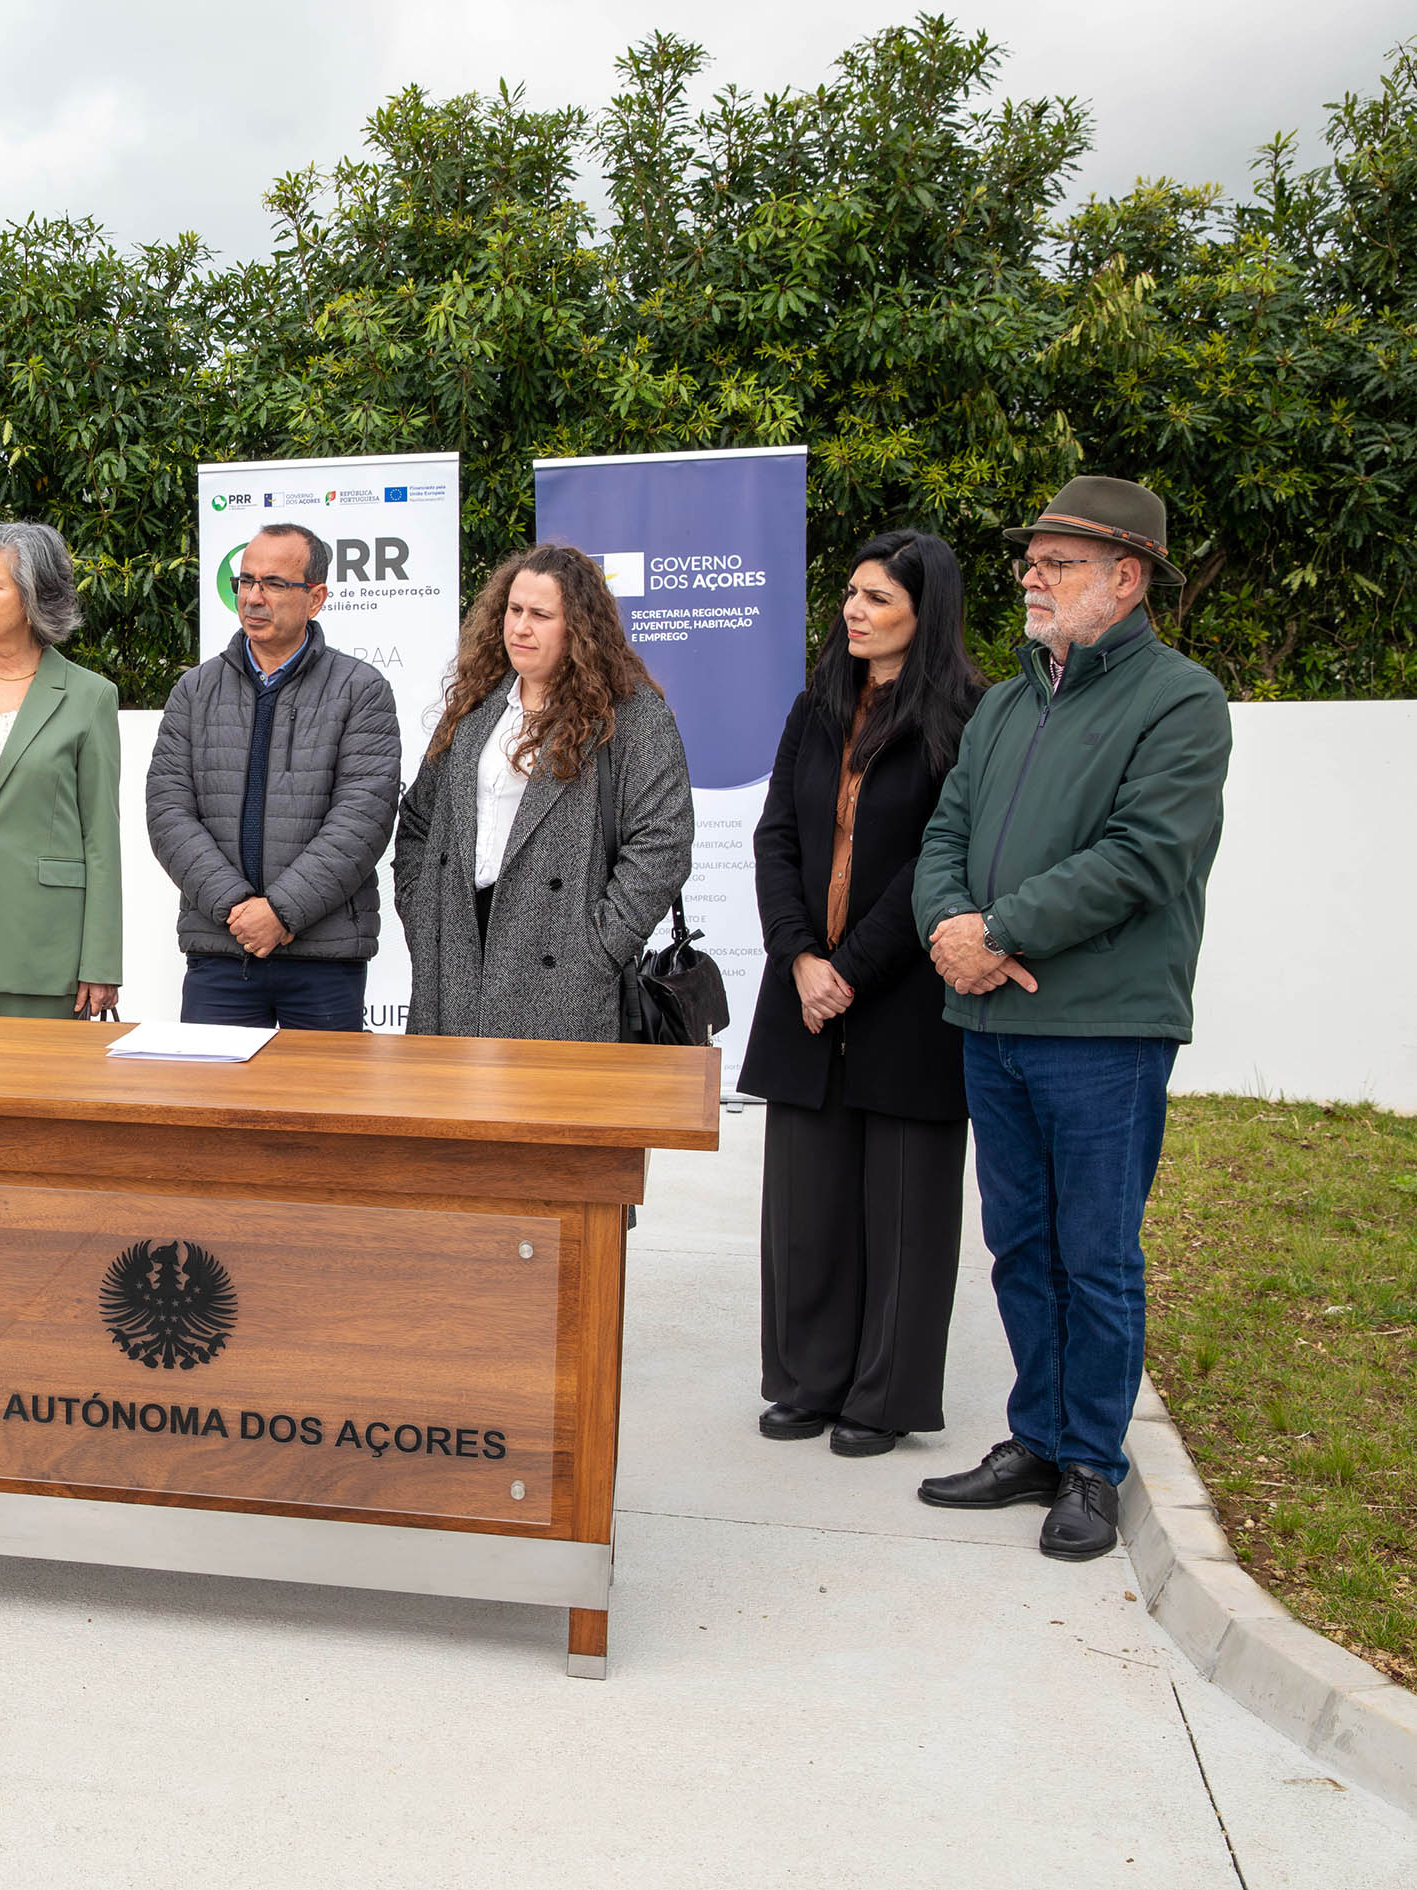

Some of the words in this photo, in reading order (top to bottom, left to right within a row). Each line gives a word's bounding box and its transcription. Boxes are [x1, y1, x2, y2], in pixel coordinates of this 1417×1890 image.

[228, 494, 252, 504] PRR
[650, 555, 742, 572] GOVERNO
[650, 575, 688, 590] DOS
[692, 571, 766, 591] AÇORES
[340, 588, 355, 598] de
[360, 586, 440, 598] Recuperação
[322, 601, 378, 611] esiliência
[631, 609, 691, 619] SECRETARIA
[692, 607, 743, 617] REGIONAL
[744, 606, 760, 616] DA
[631, 620, 692, 631] JUVENTUDE,
[693, 617, 753, 629] HABITAÇÃO
[631, 633, 638, 642] E
[639, 632, 688, 642] EMPREGO
[696, 820, 743, 828] UVENTUDE
[693, 840, 743, 850] HABITAÇÃO
[709, 948, 727, 956] DOS
[729, 947, 763, 956] AÇORES
[2, 1392, 229, 1438] AUTÓNOMA
[240, 1411, 324, 1446] DOS
[334, 1420, 507, 1460] AÇORES
